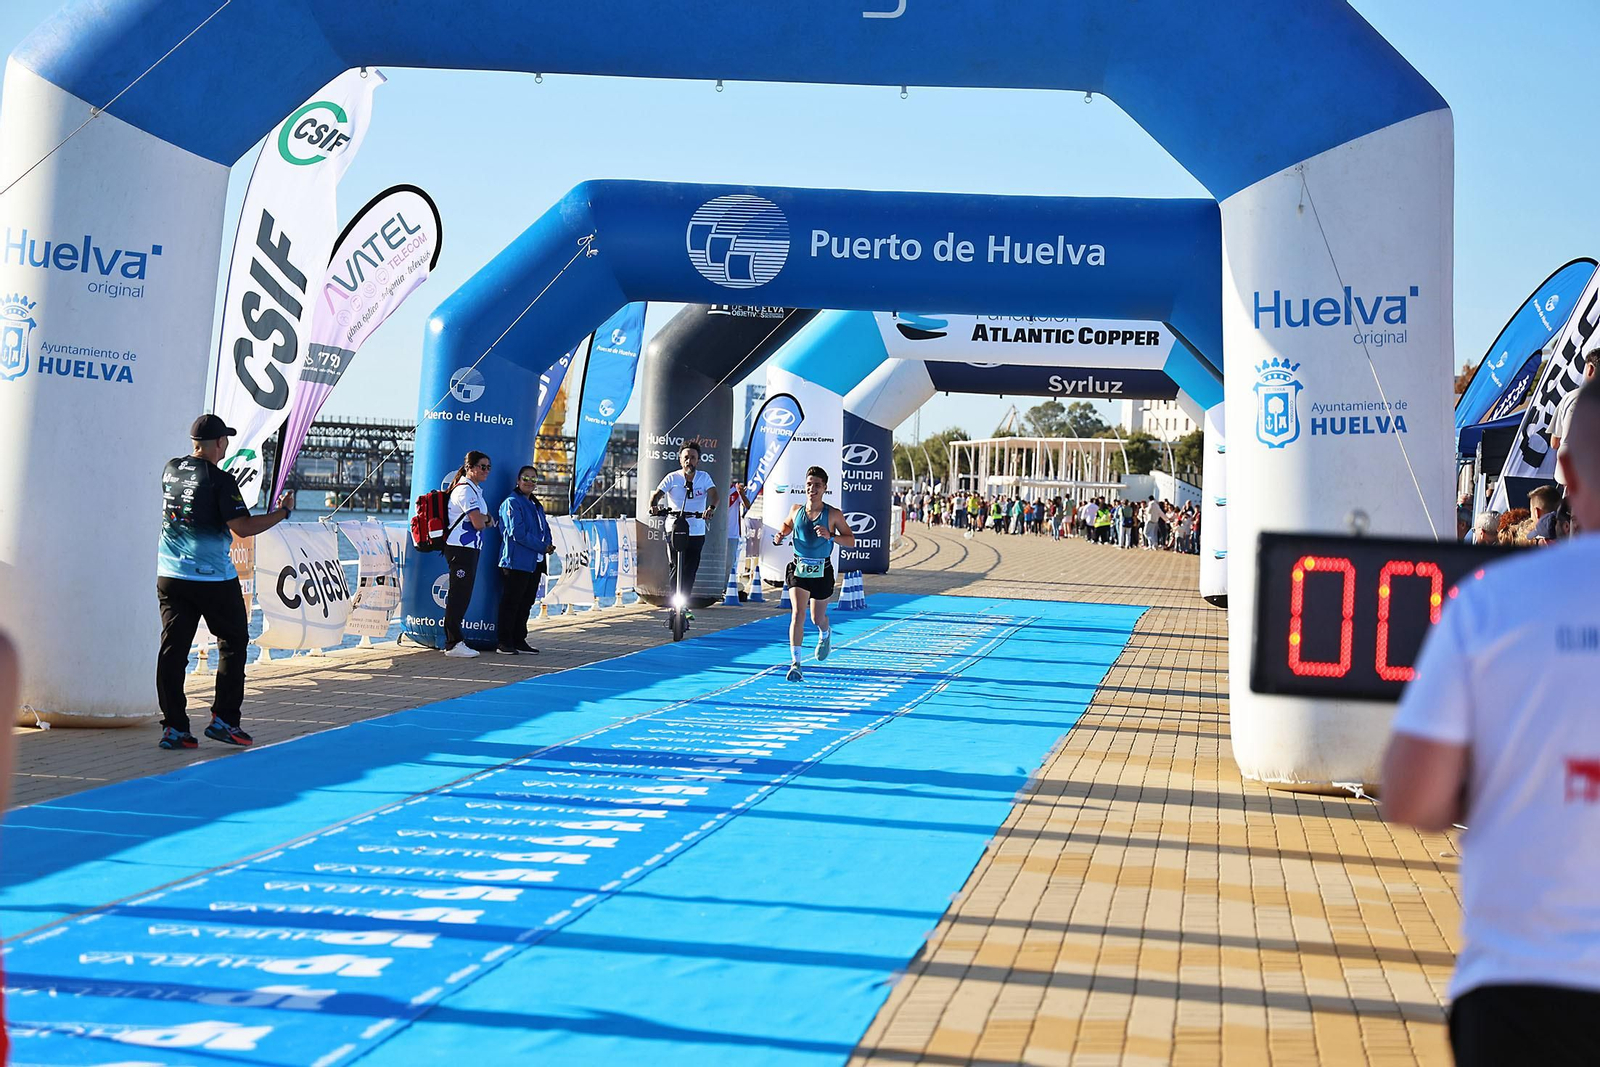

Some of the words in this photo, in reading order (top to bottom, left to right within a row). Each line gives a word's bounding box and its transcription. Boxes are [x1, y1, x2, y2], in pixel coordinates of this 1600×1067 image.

[294, 118, 350, 151] CSIF
[4, 227, 148, 281] Huelva
[387, 233, 427, 270] TELECOM
[810, 229, 922, 262] Puerto
[933, 232, 974, 263] de
[987, 235, 1106, 267] Huelva
[323, 212, 421, 316] AVATEL
[87, 280, 145, 298] original
[234, 208, 307, 411] CSIF
[1254, 286, 1407, 329] Huelva
[971, 324, 1074, 345] ATLANTIC
[1078, 327, 1160, 346] COPPER
[1353, 330, 1408, 347] original
[40, 341, 120, 359] Ayuntamiento
[122, 351, 137, 361] de
[38, 356, 134, 383] HUELVA
[1048, 375, 1123, 395] Syrluz
[1311, 401, 1393, 415] Ayuntamiento
[1395, 400, 1408, 410] de
[424, 409, 453, 420] Puerto
[456, 411, 471, 421] de
[474, 412, 514, 426] Huelva
[1311, 416, 1408, 435] HUELVA
[646, 432, 684, 446] Huelva
[760, 426, 794, 437] HYUNDAI
[646, 448, 660, 460] tus
[748, 441, 781, 493] Syrluz
[843, 482, 873, 493] Syrluz
[840, 550, 870, 561] Syrluz
[801, 565, 820, 573] 162
[406, 615, 435, 627] Puerto
